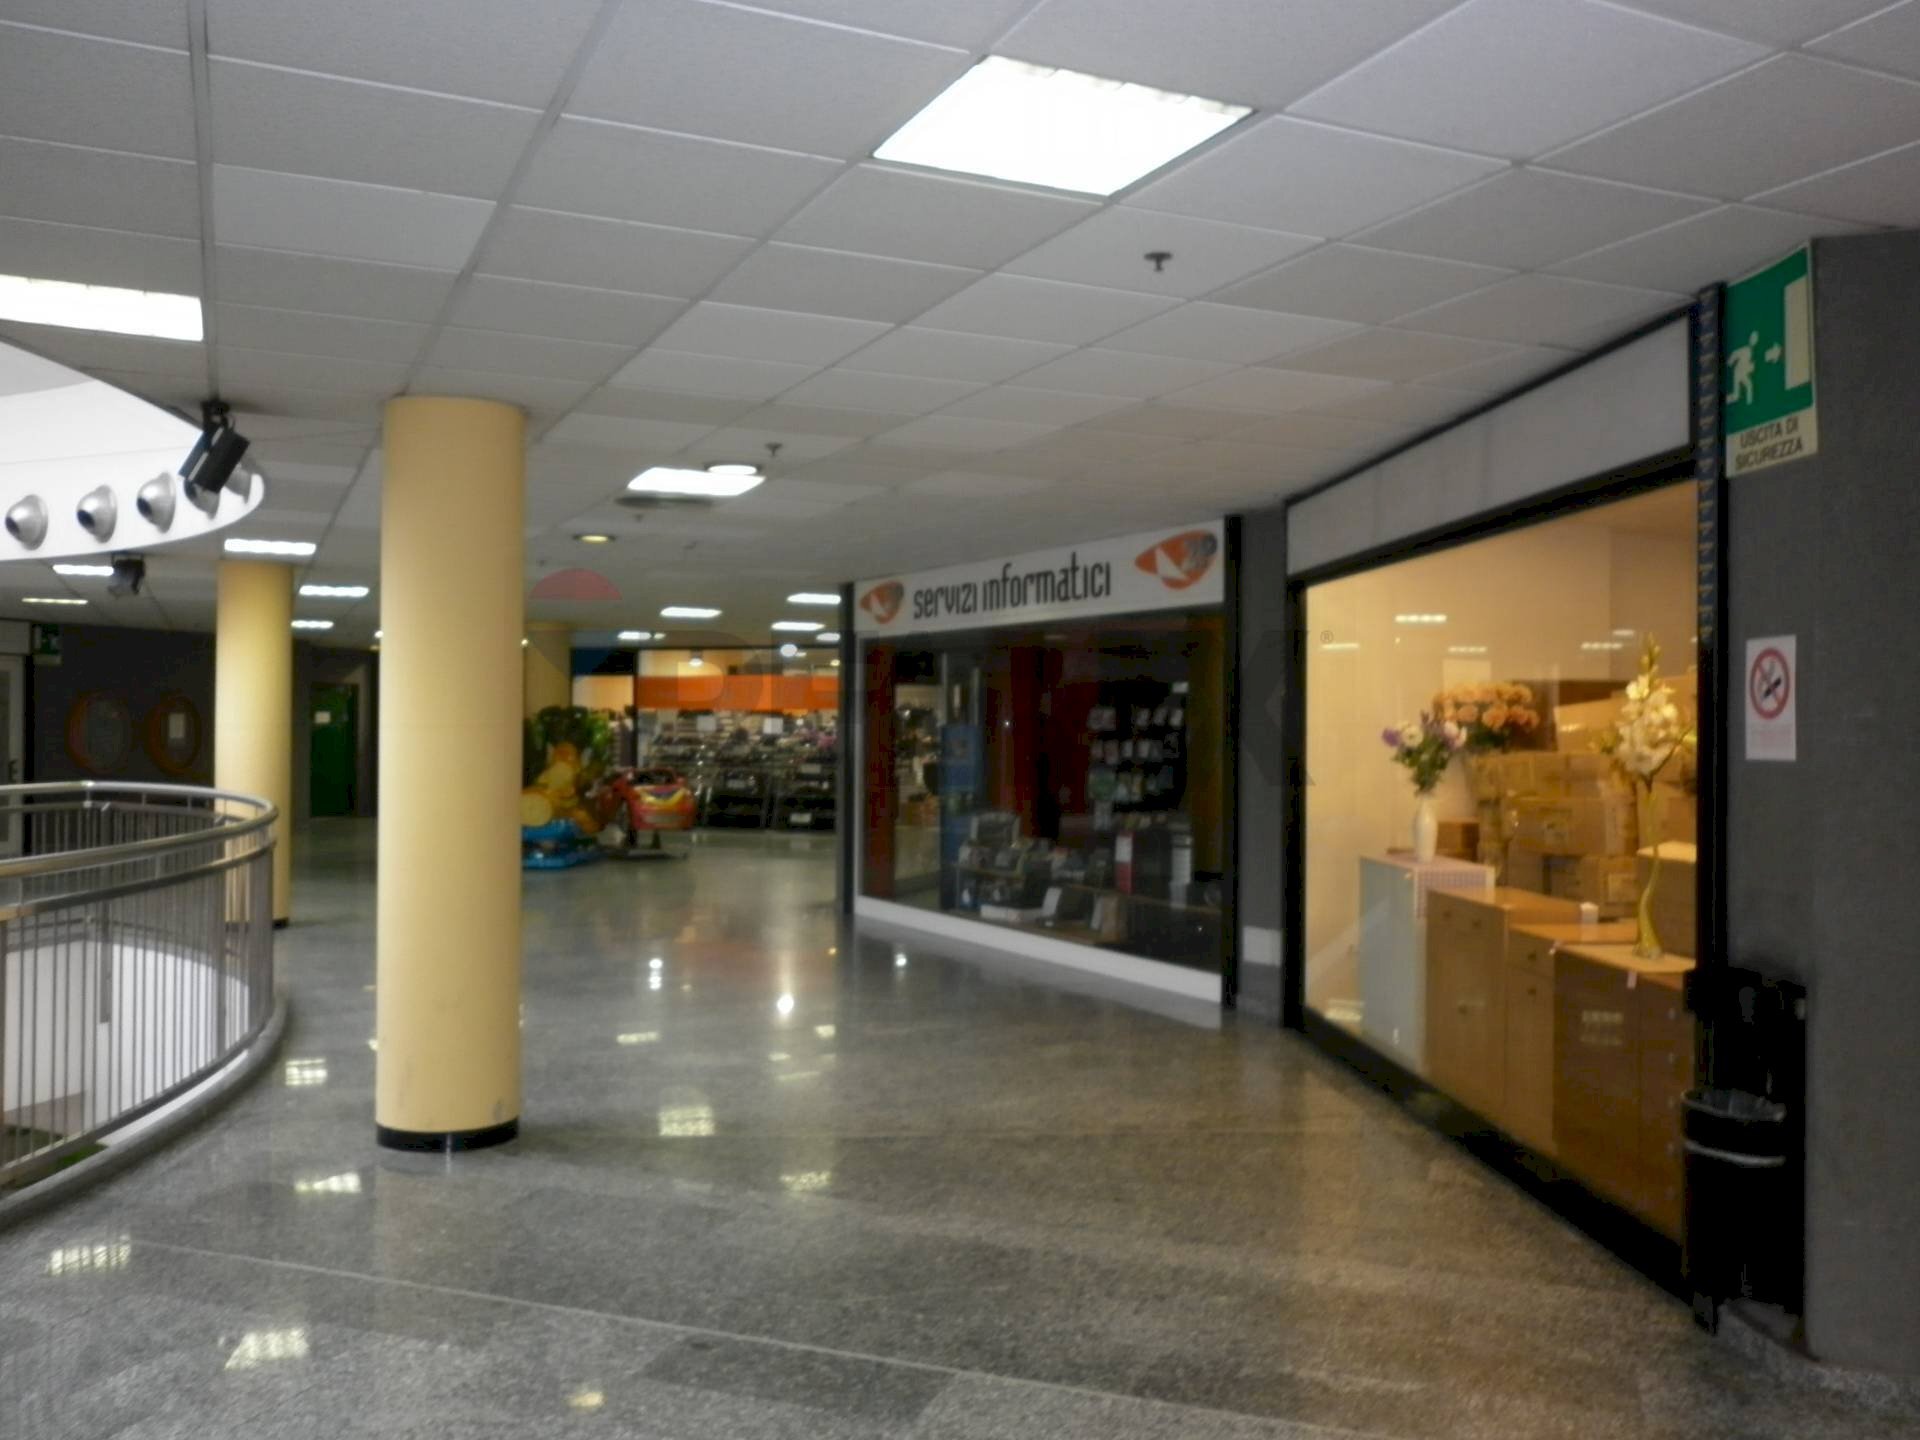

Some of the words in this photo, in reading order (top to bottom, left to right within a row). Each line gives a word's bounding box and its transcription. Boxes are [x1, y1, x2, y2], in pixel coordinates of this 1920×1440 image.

[1740, 421, 1782, 449] USCITA
[1786, 415, 1799, 435] DI
[1735, 436, 1803, 470] SICUREZZA
[913, 582, 978, 620] servizi
[982, 551, 1111, 612] informatici
